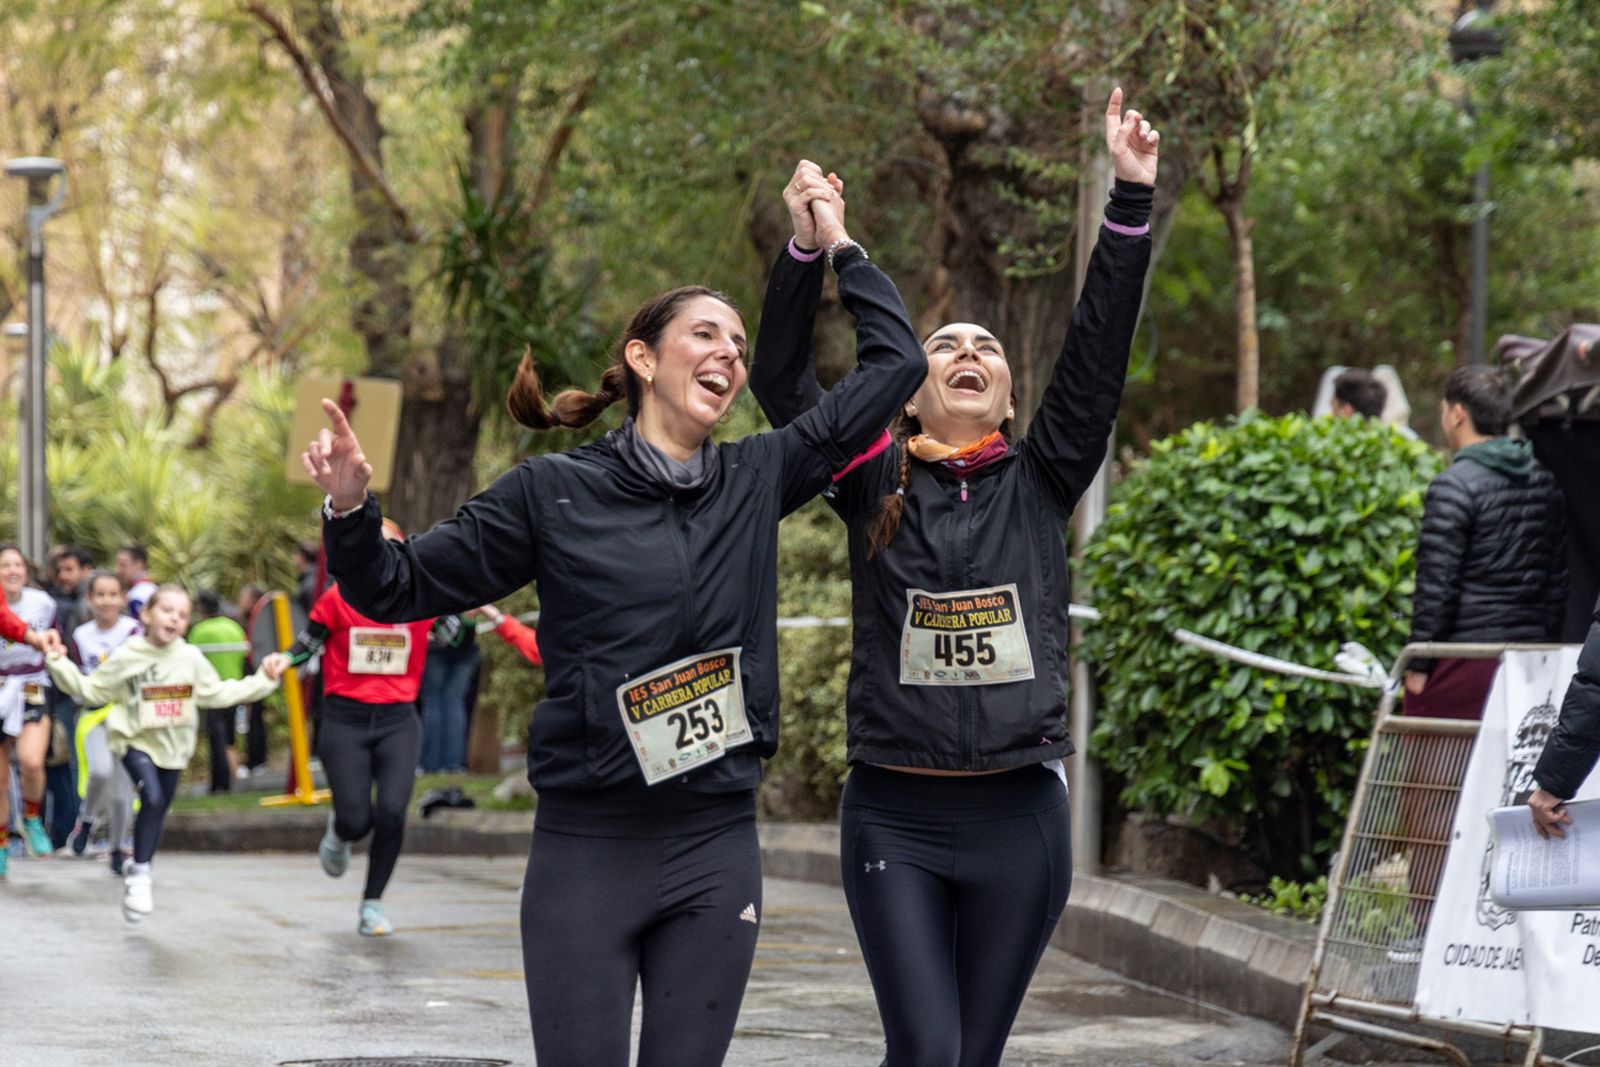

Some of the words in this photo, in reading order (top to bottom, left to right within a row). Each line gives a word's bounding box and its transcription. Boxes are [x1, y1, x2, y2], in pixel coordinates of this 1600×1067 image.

[915, 611, 922, 625] V
[969, 608, 1012, 627] POPULAR
[951, 599, 973, 612] Juan
[975, 595, 1005, 609] Bosco
[934, 631, 996, 667] 455
[628, 687, 648, 703] IES
[649, 680, 673, 695] San
[673, 668, 698, 687] Juan
[697, 657, 726, 675] Bosco
[630, 705, 641, 720] V
[643, 688, 694, 715] CARRERA
[694, 669, 731, 697] POPULAR
[667, 698, 724, 751] 253
[1484, 946, 1502, 969] DE
